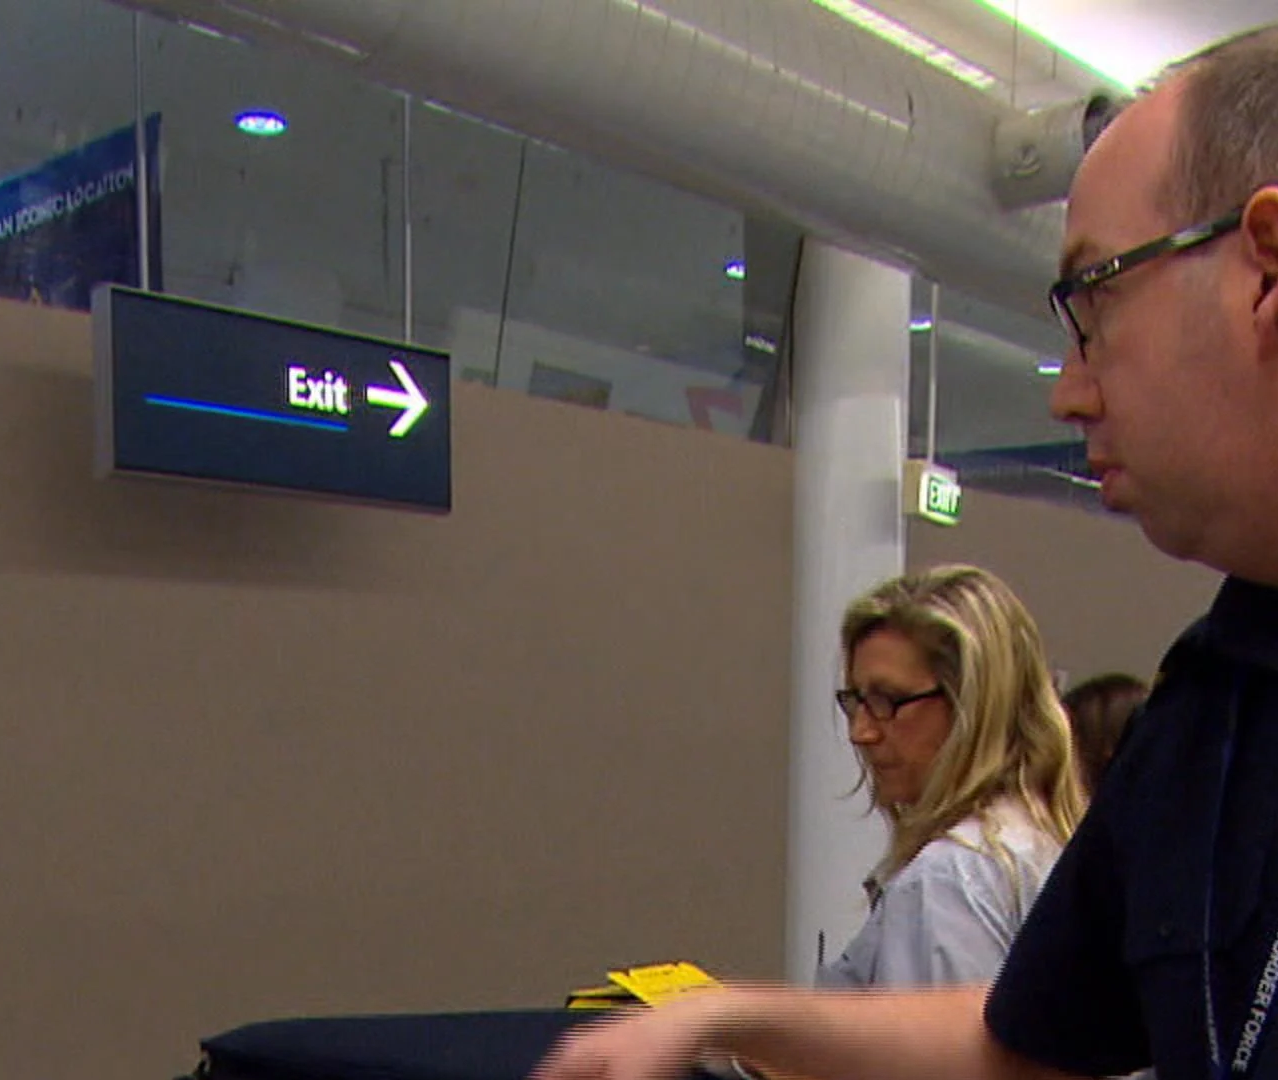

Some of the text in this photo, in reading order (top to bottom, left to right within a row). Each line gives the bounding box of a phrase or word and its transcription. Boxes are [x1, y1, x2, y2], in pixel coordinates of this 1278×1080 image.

[15, 197, 65, 232] ICONIC
[64, 162, 135, 212] LOCATION
[288, 364, 349, 415] Exit
[1231, 1006, 1266, 1073] FORCE
